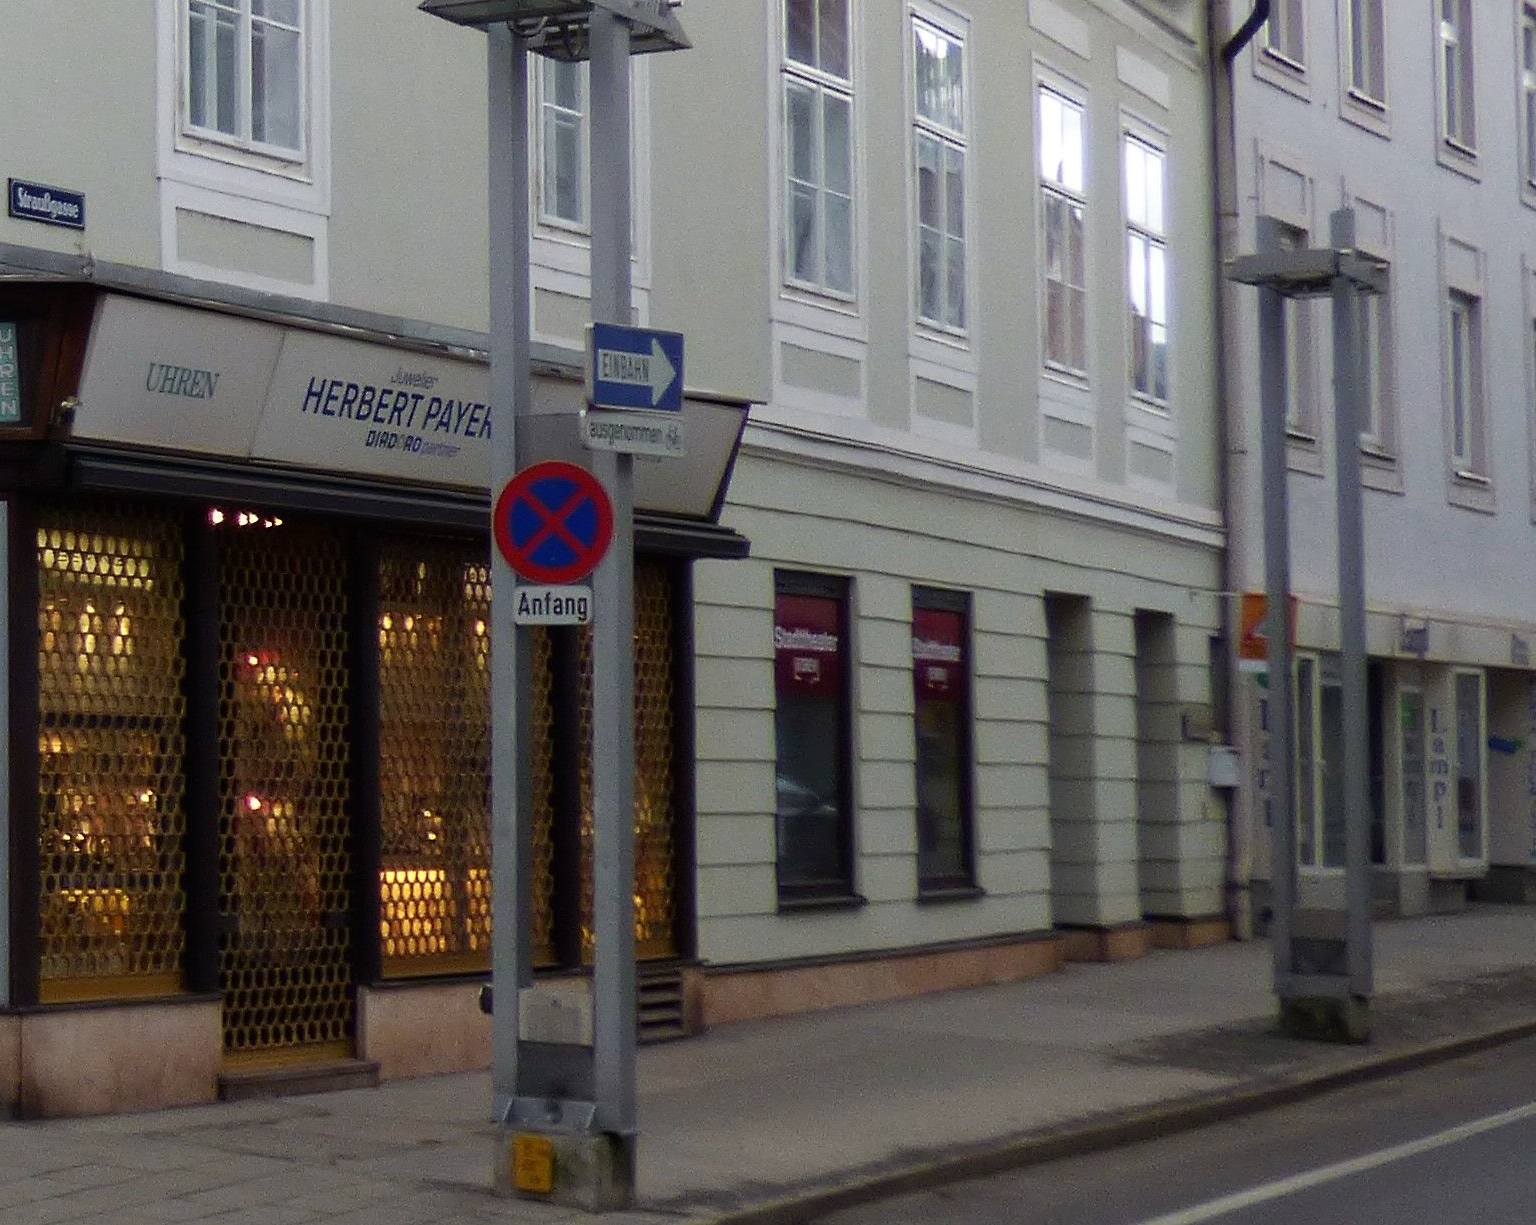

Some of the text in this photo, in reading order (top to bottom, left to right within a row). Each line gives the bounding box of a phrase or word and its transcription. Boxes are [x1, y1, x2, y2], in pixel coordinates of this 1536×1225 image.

[145, 362, 220, 400] UHREN
[602, 353, 649, 382] EINBAHN
[302, 376, 424, 428] HERBERT
[518, 591, 589, 622] Anfang
